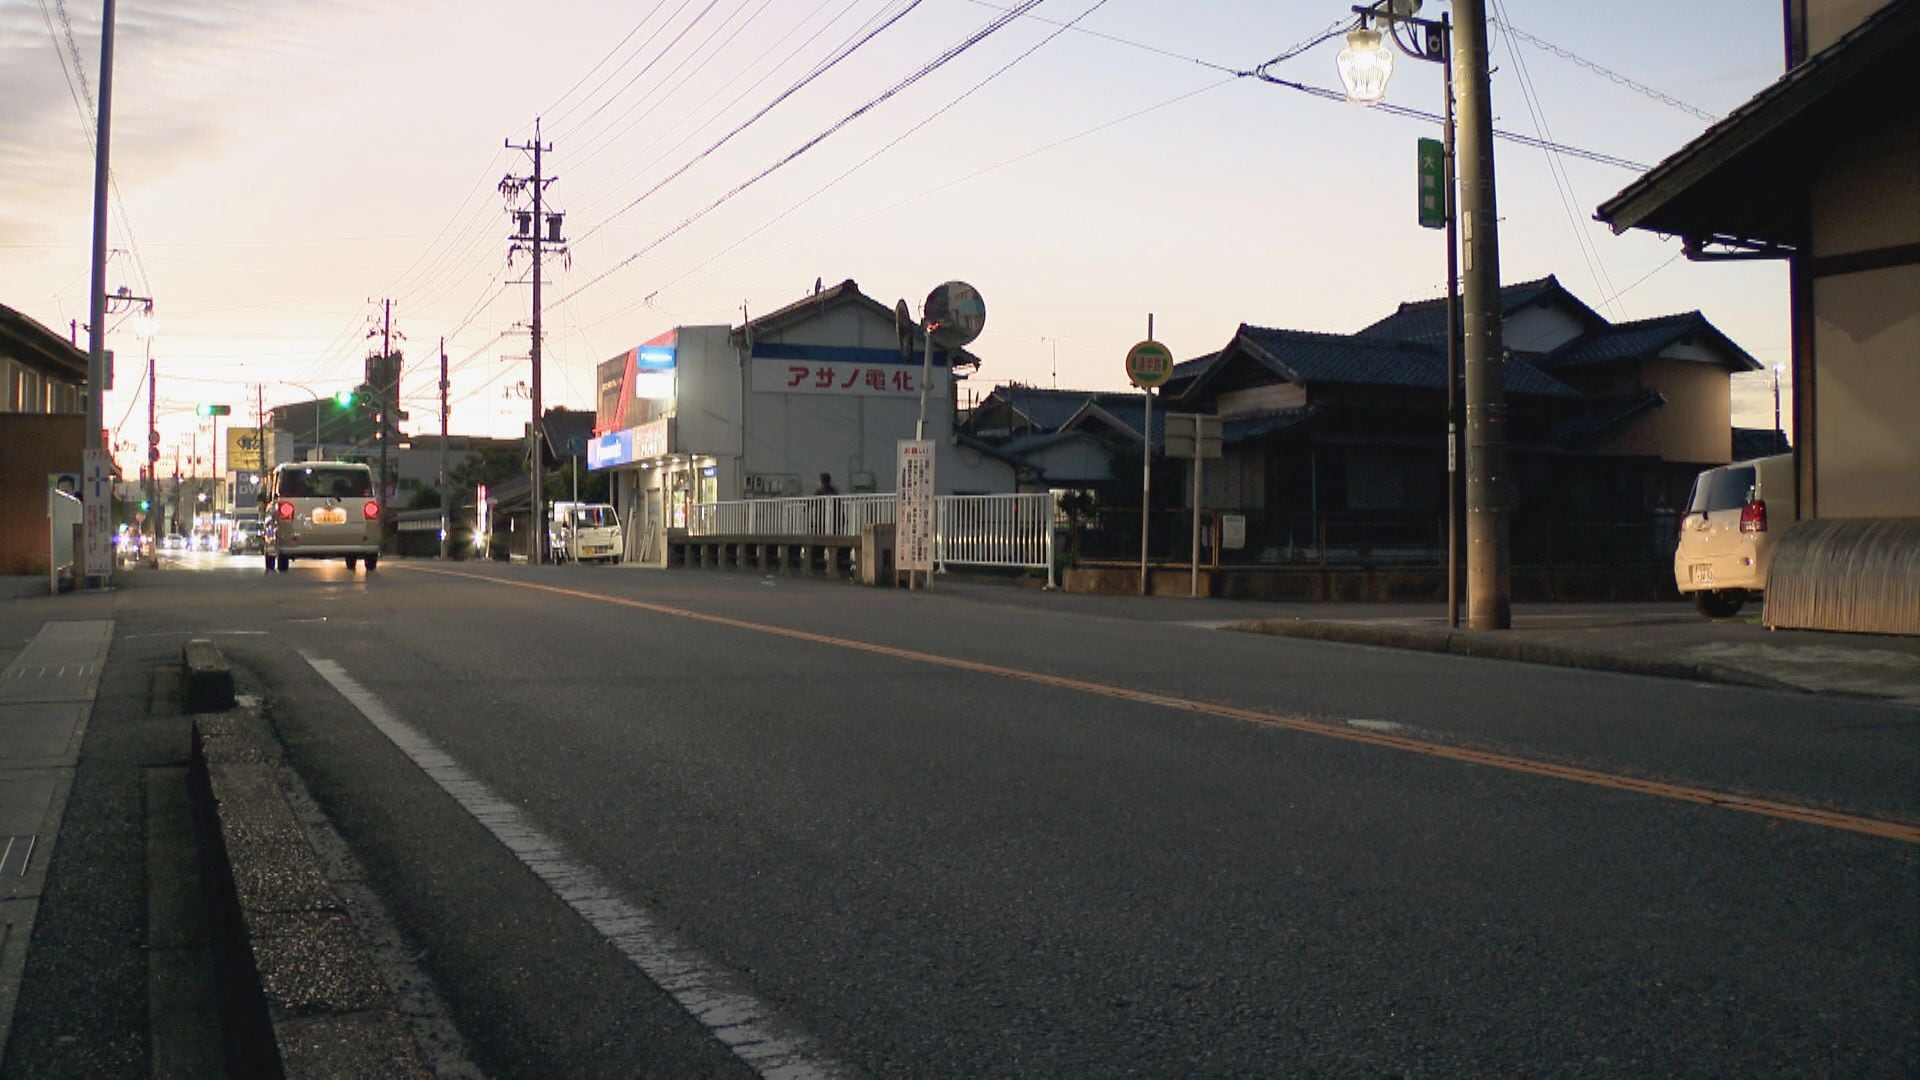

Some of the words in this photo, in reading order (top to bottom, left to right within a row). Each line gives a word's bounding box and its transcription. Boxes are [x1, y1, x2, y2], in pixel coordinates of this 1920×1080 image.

[787, 366, 914, 391] アサノ電化
